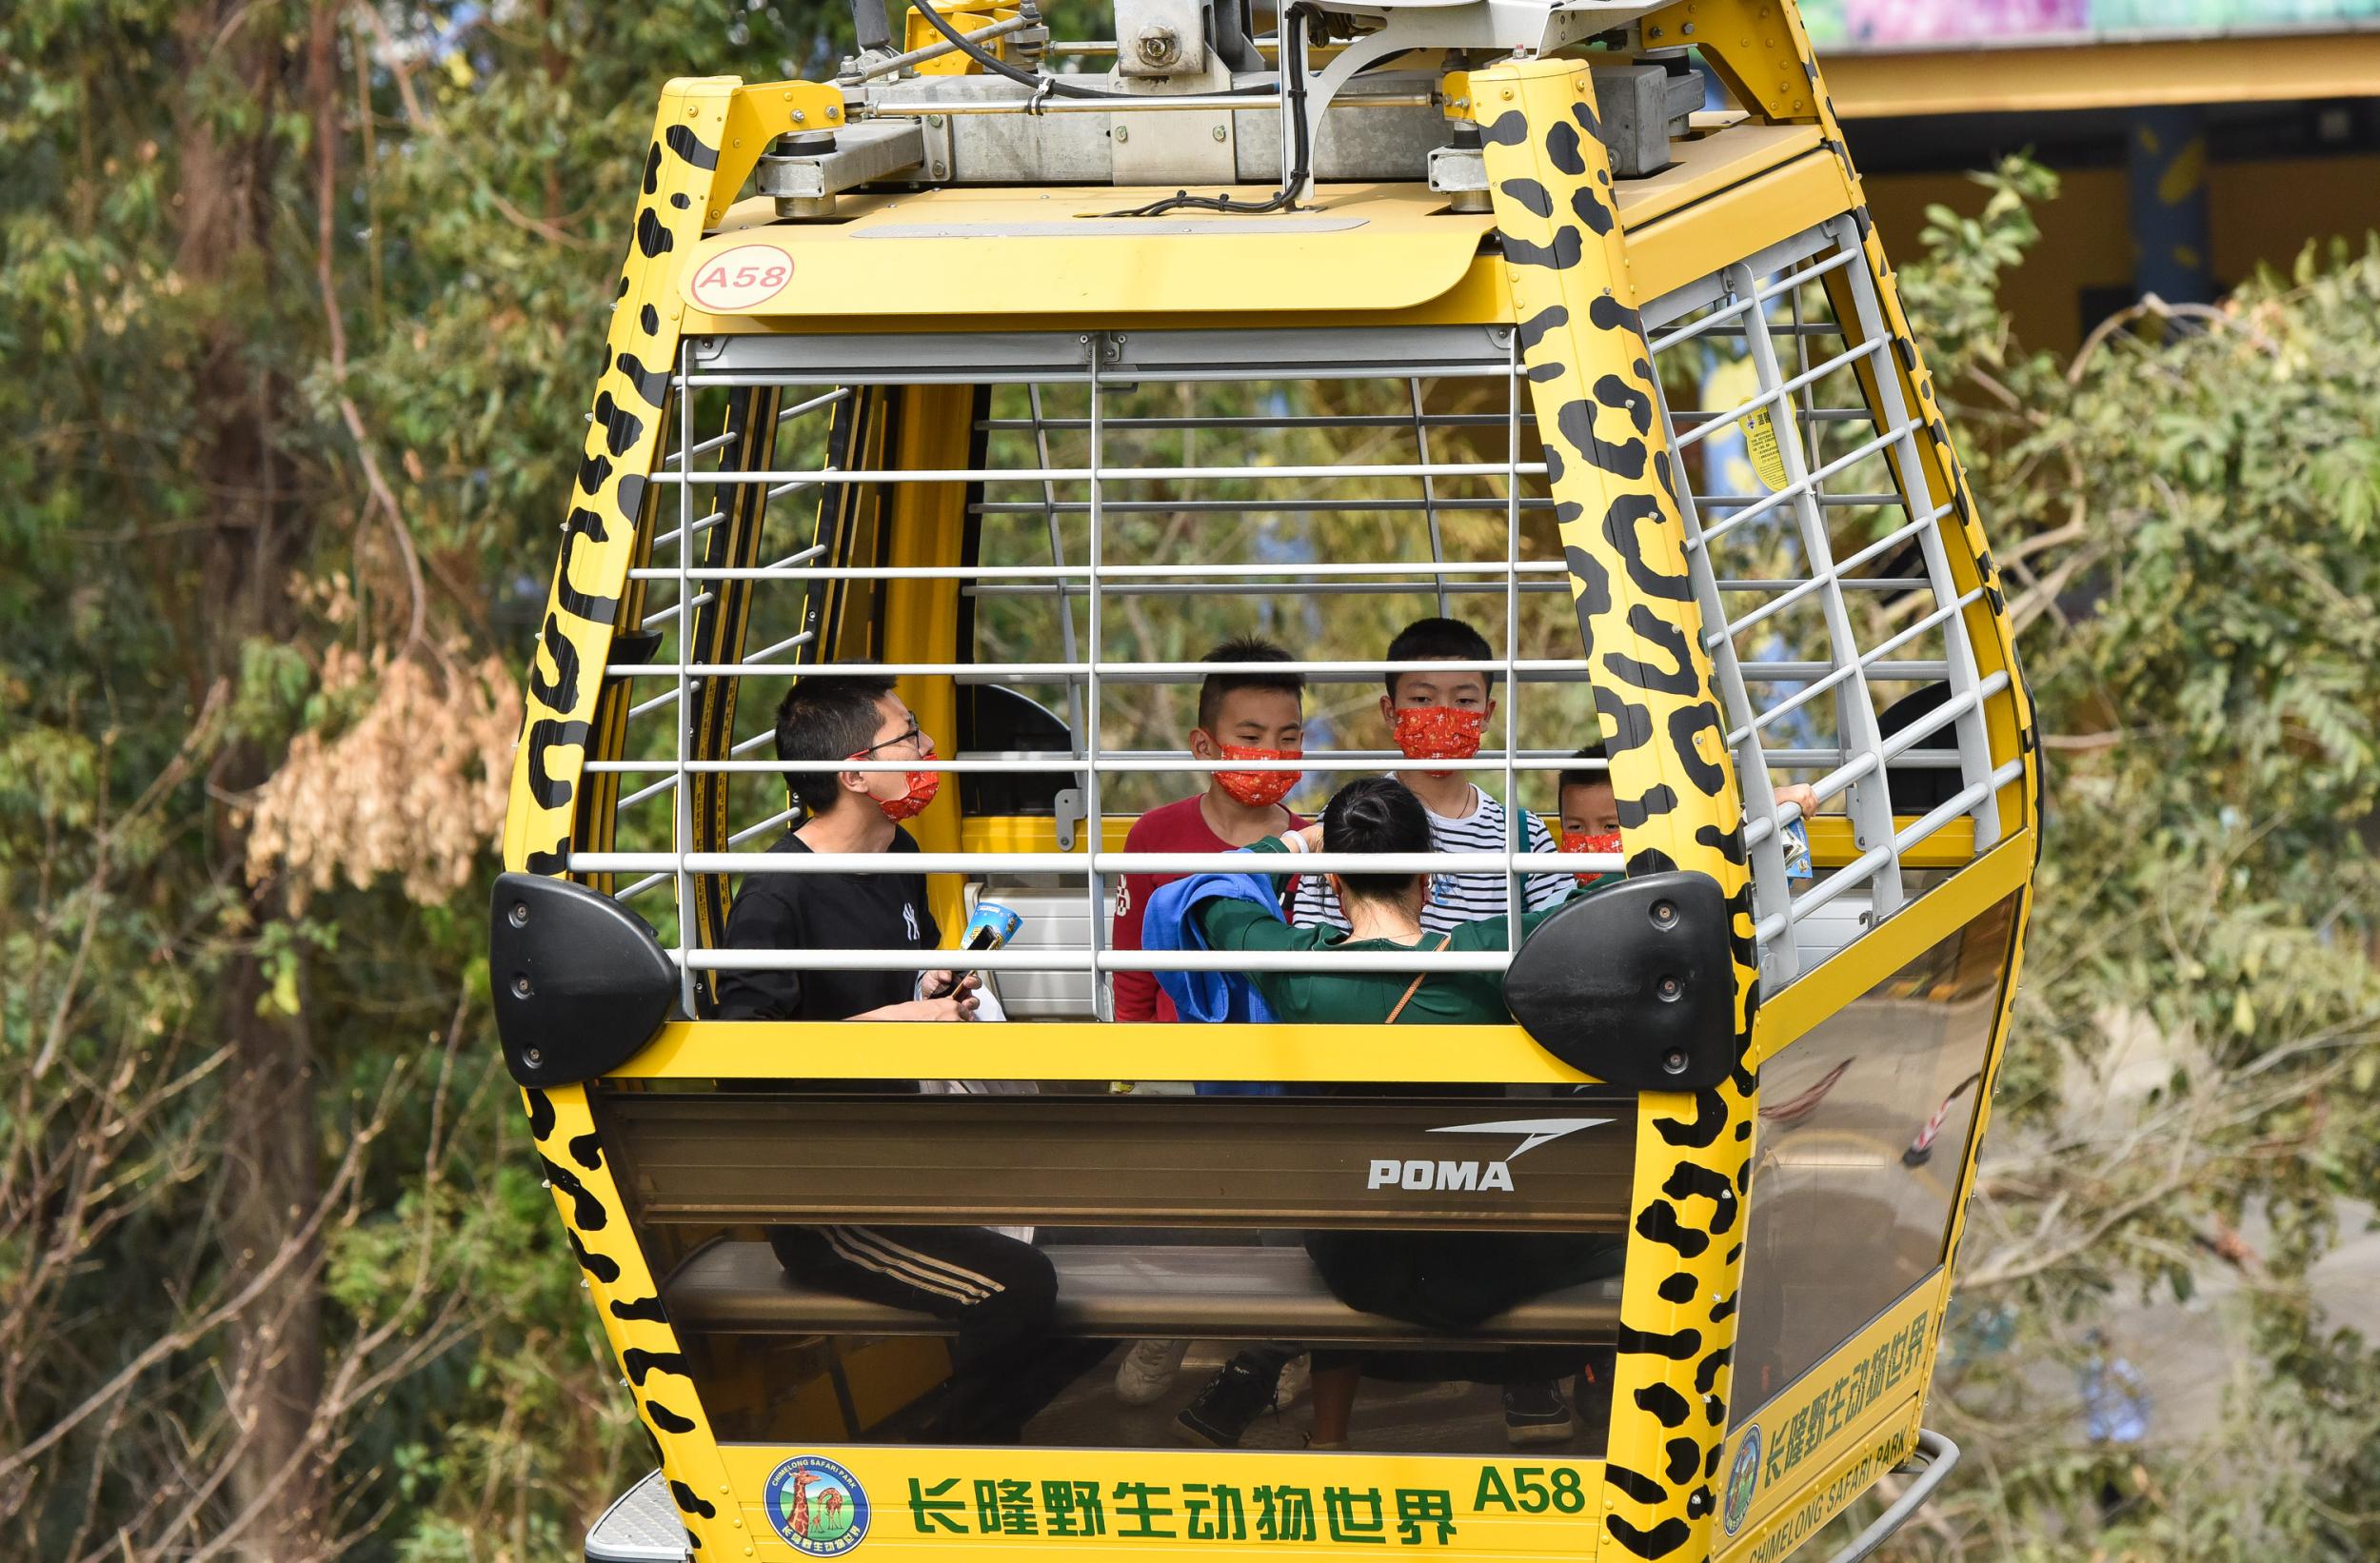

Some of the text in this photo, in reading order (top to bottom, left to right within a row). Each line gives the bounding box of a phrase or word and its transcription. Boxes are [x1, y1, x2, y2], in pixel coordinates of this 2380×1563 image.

[699, 267, 786, 287] A58
[1367, 1159, 1515, 1192] POMA
[1764, 1310, 1929, 1489] 长隆野生动物世界
[771, 1459, 857, 1489] CHIMELONG SAFARI PARK
[1473, 1465, 1586, 1514] A58
[1827, 1454, 1873, 1514] SAFARI
[1874, 1424, 1908, 1475] PARK
[907, 1477, 1457, 1546] 长隆野生动物世界
